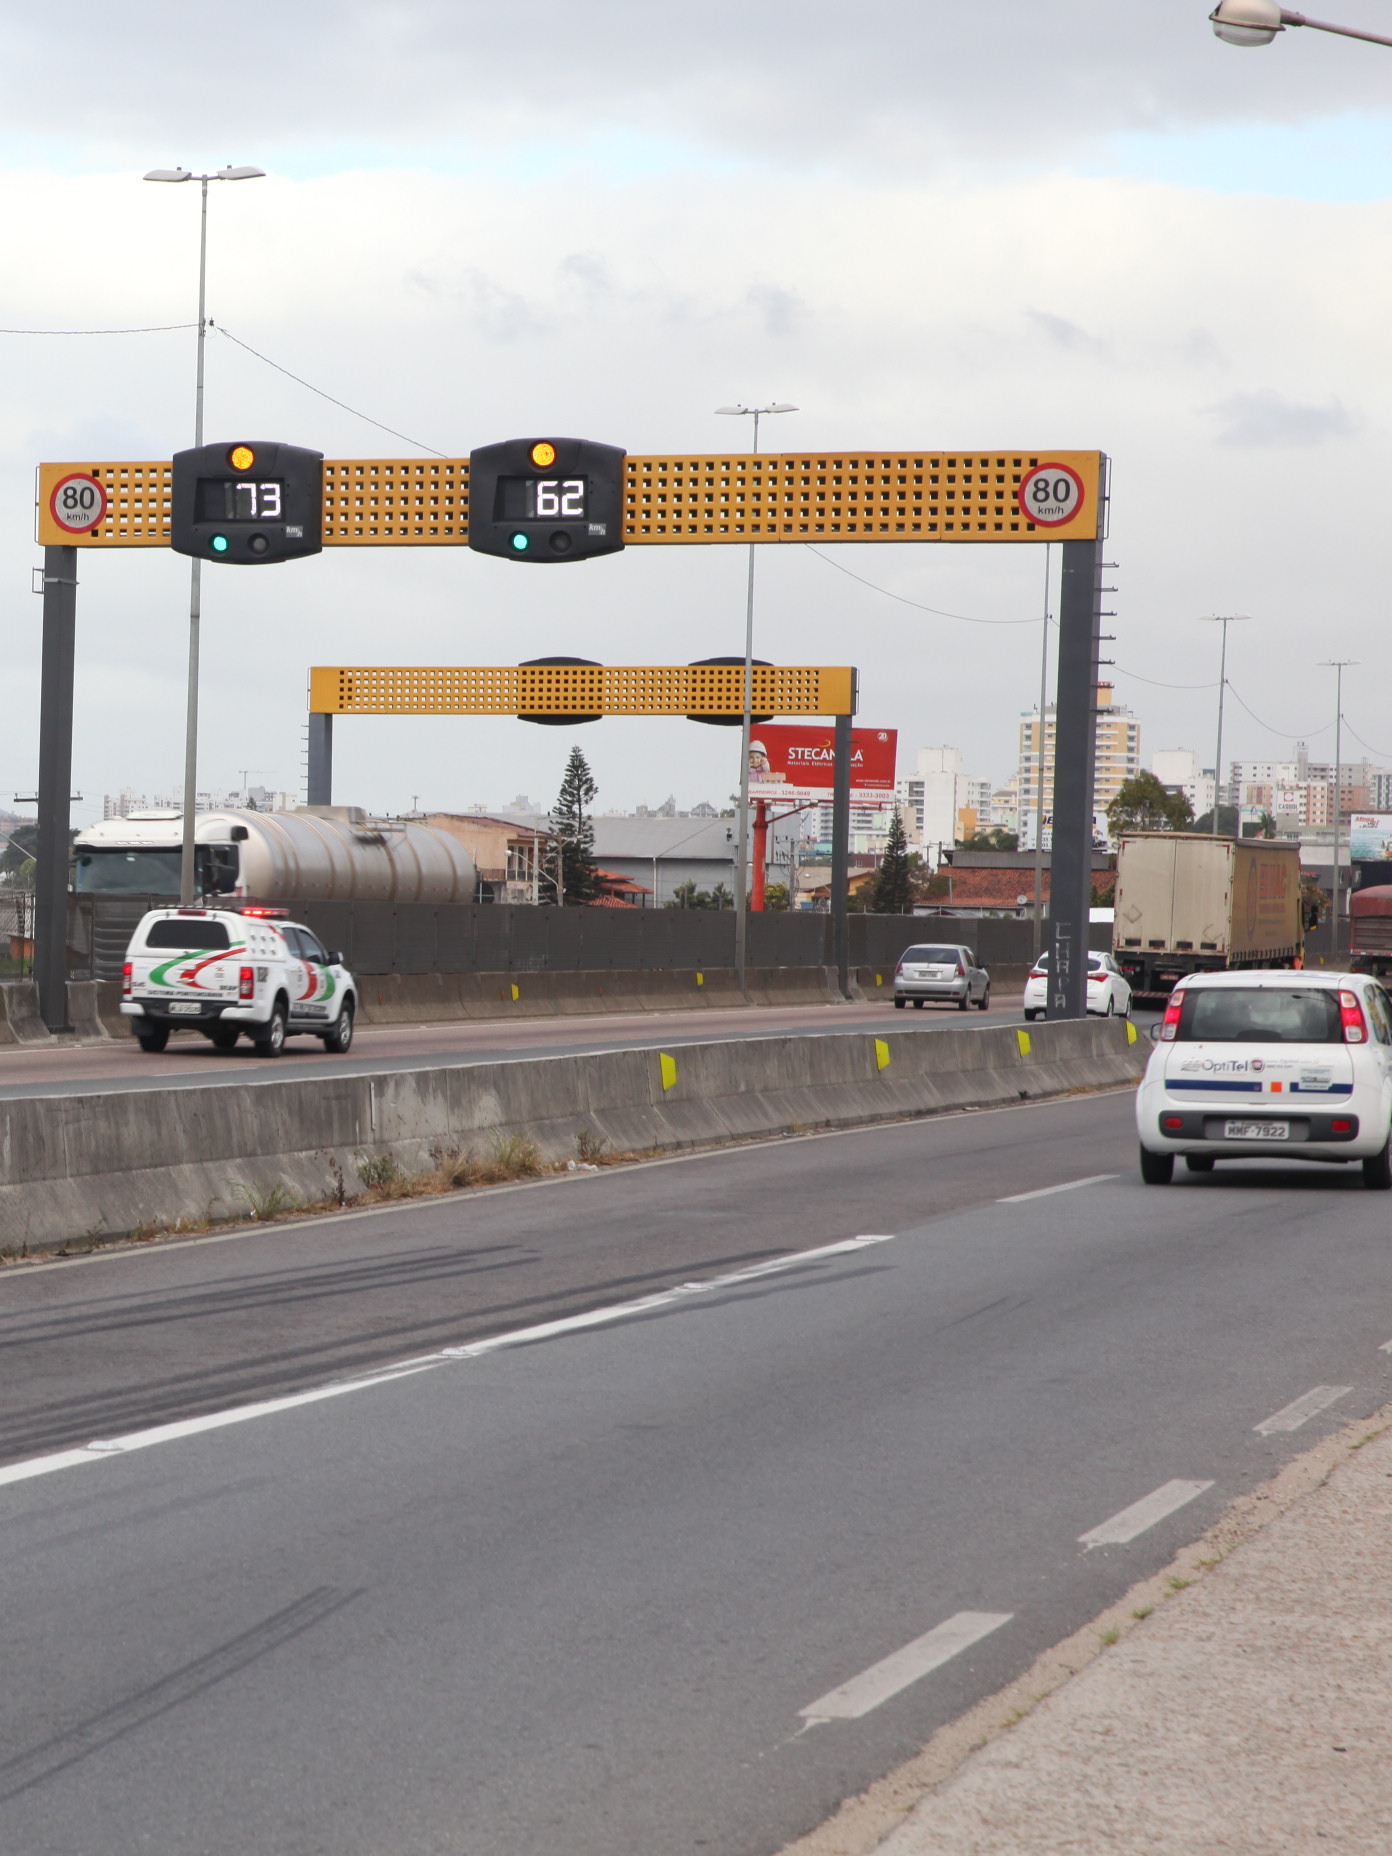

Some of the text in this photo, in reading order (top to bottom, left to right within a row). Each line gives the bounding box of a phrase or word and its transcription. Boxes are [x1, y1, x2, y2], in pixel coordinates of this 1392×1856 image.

[63, 486, 95, 510] 80
[236, 483, 281, 516] 73
[537, 481, 584, 515] 62
[1032, 478, 1070, 503] 80
[66, 512, 90, 521] km/h
[1038, 506, 1064, 515] km/h
[1202, 1059, 1248, 1074] OptiTel
